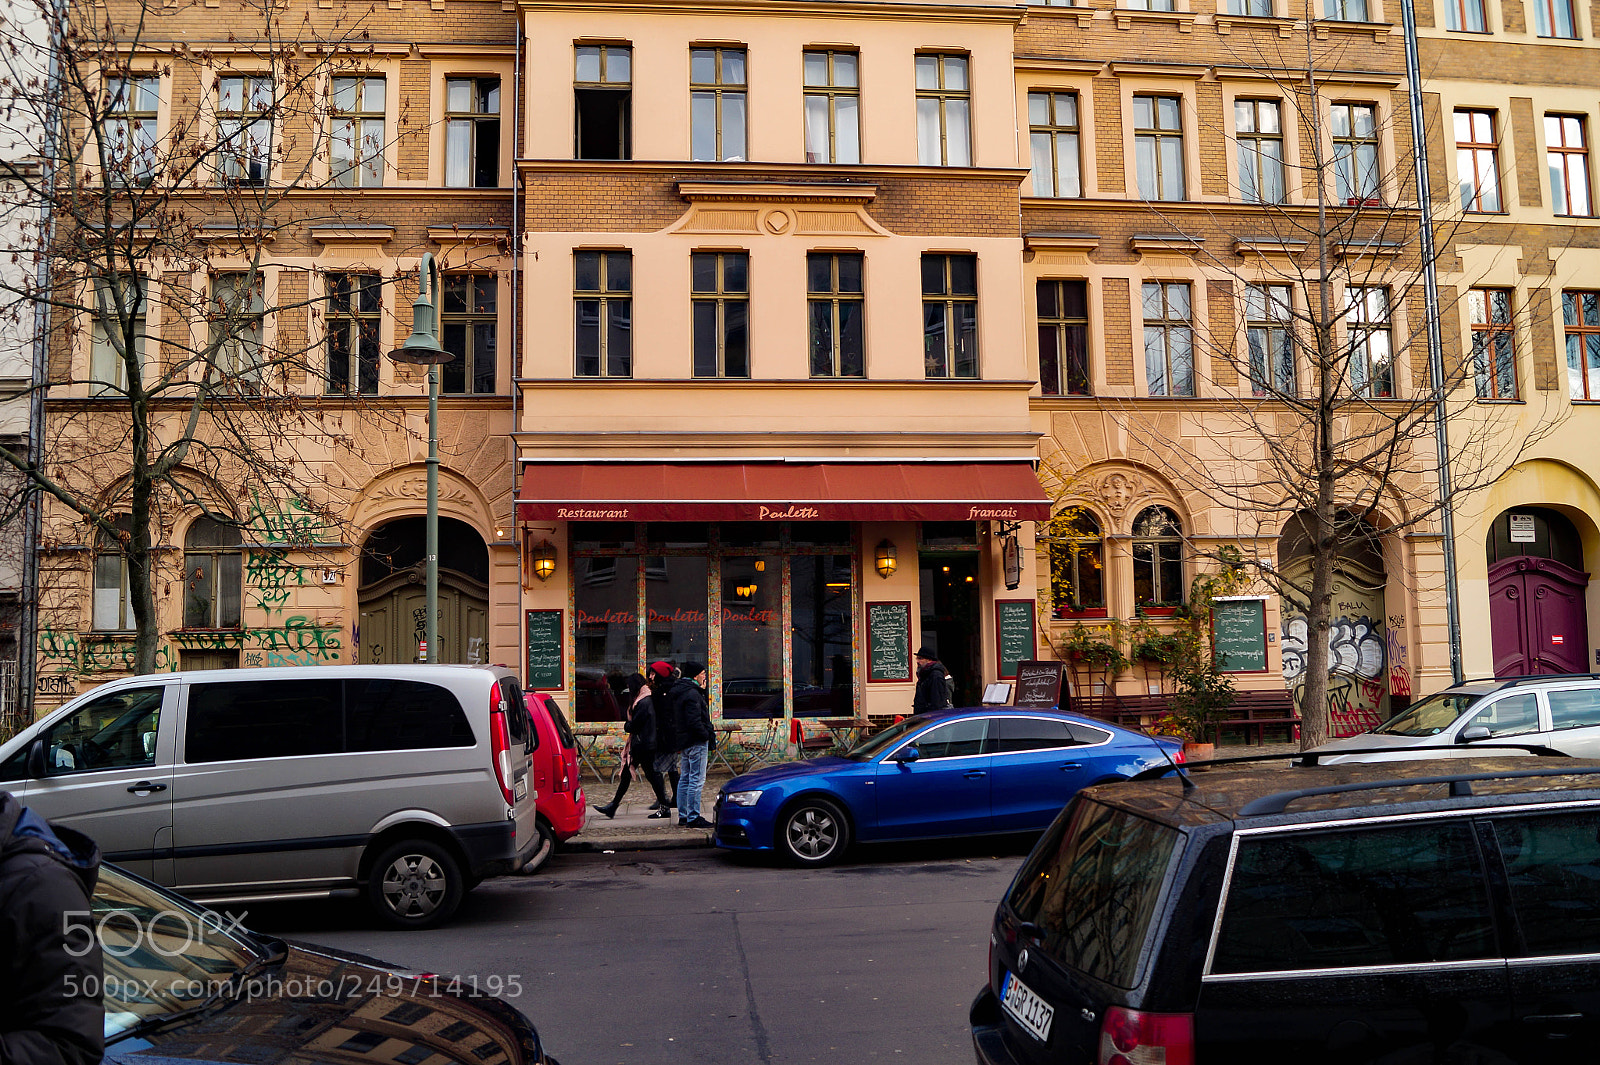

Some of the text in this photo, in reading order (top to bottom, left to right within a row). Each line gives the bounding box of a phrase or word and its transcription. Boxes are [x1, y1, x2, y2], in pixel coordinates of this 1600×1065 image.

[557, 508, 629, 518] Restaurant
[759, 505, 819, 520] Poulette
[966, 506, 1018, 521] francais
[577, 610, 636, 625] Poulette
[648, 608, 706, 625] Poulette
[722, 607, 779, 625] Poulette
[1005, 977, 1013, 1001] B
[1025, 996, 1053, 1034] 1137
